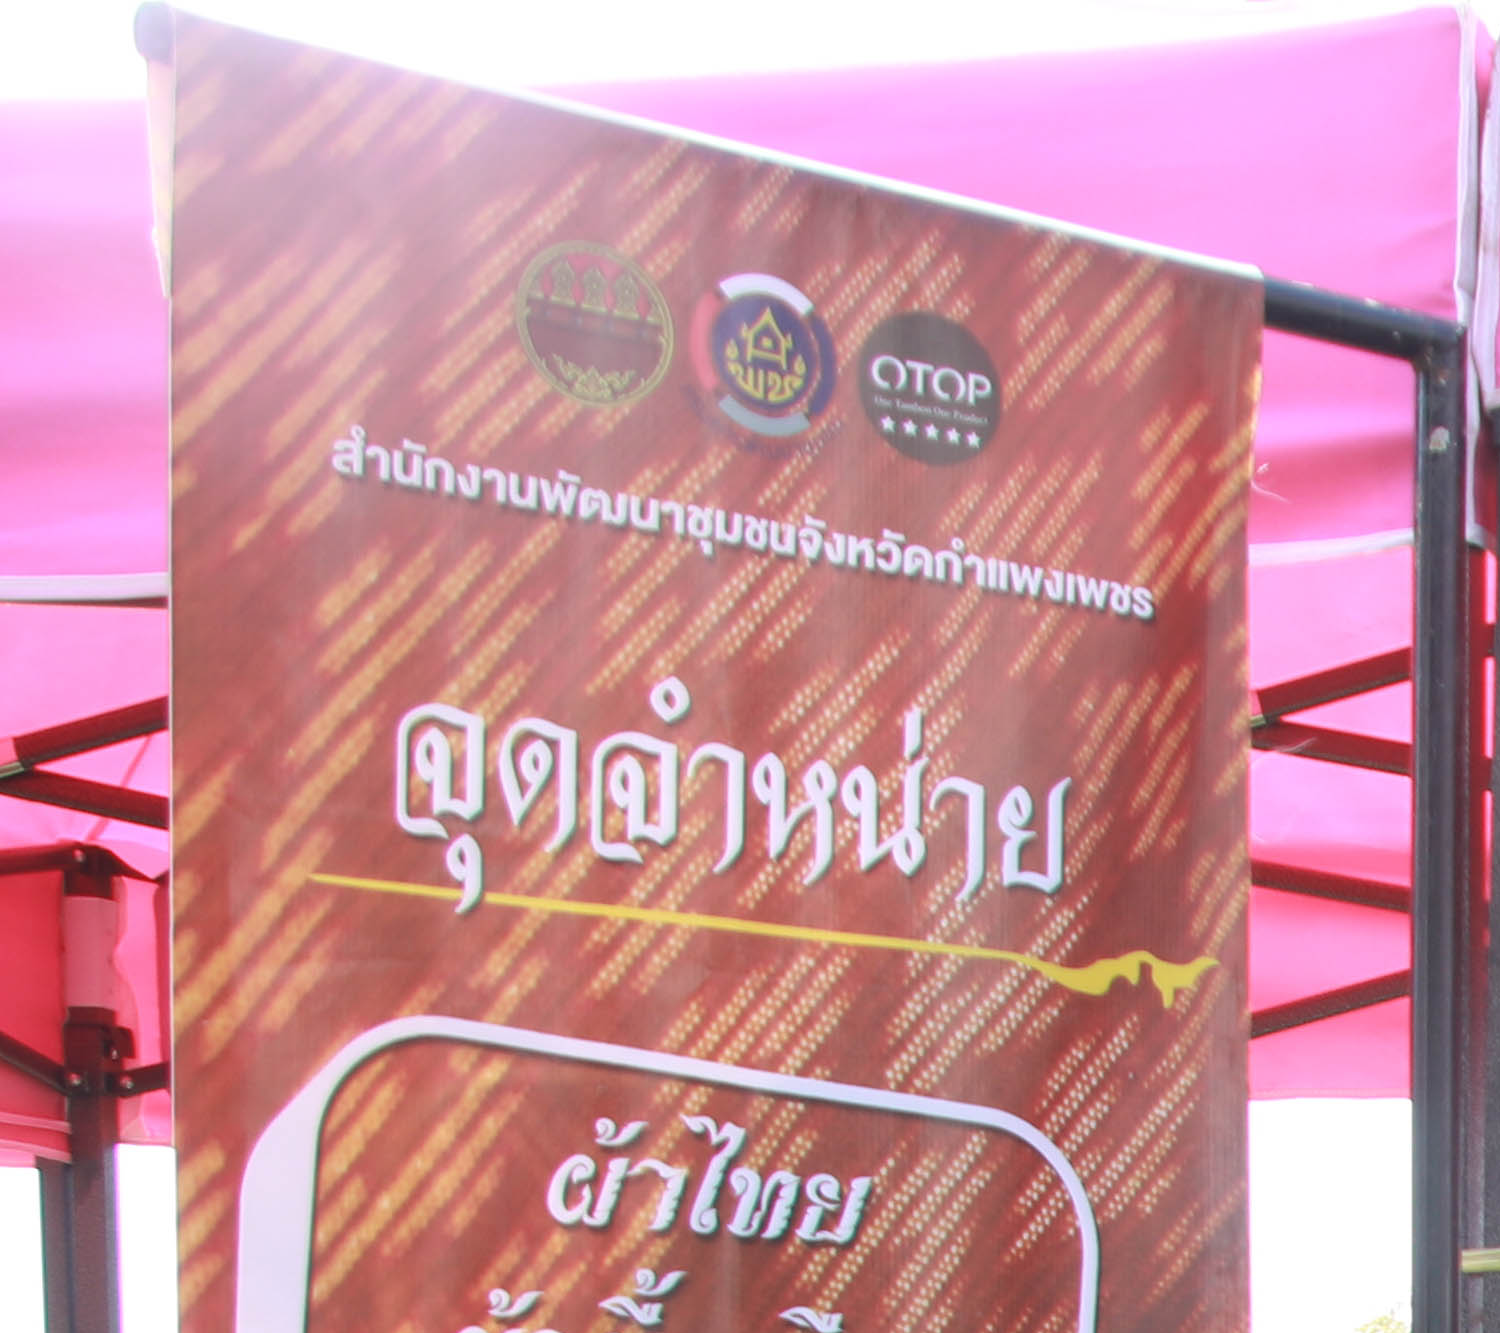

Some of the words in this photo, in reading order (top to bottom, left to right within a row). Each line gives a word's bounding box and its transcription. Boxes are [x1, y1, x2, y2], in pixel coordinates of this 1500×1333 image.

[871, 354, 993, 407] OTOP
[331, 424, 1156, 620] สำนักงานพัฒนาชุมชนจังหวัดกำแพงเพชร
[396, 675, 1072, 914] จุดจำหน่าย
[546, 1112, 873, 1244] ผ้าไทย
